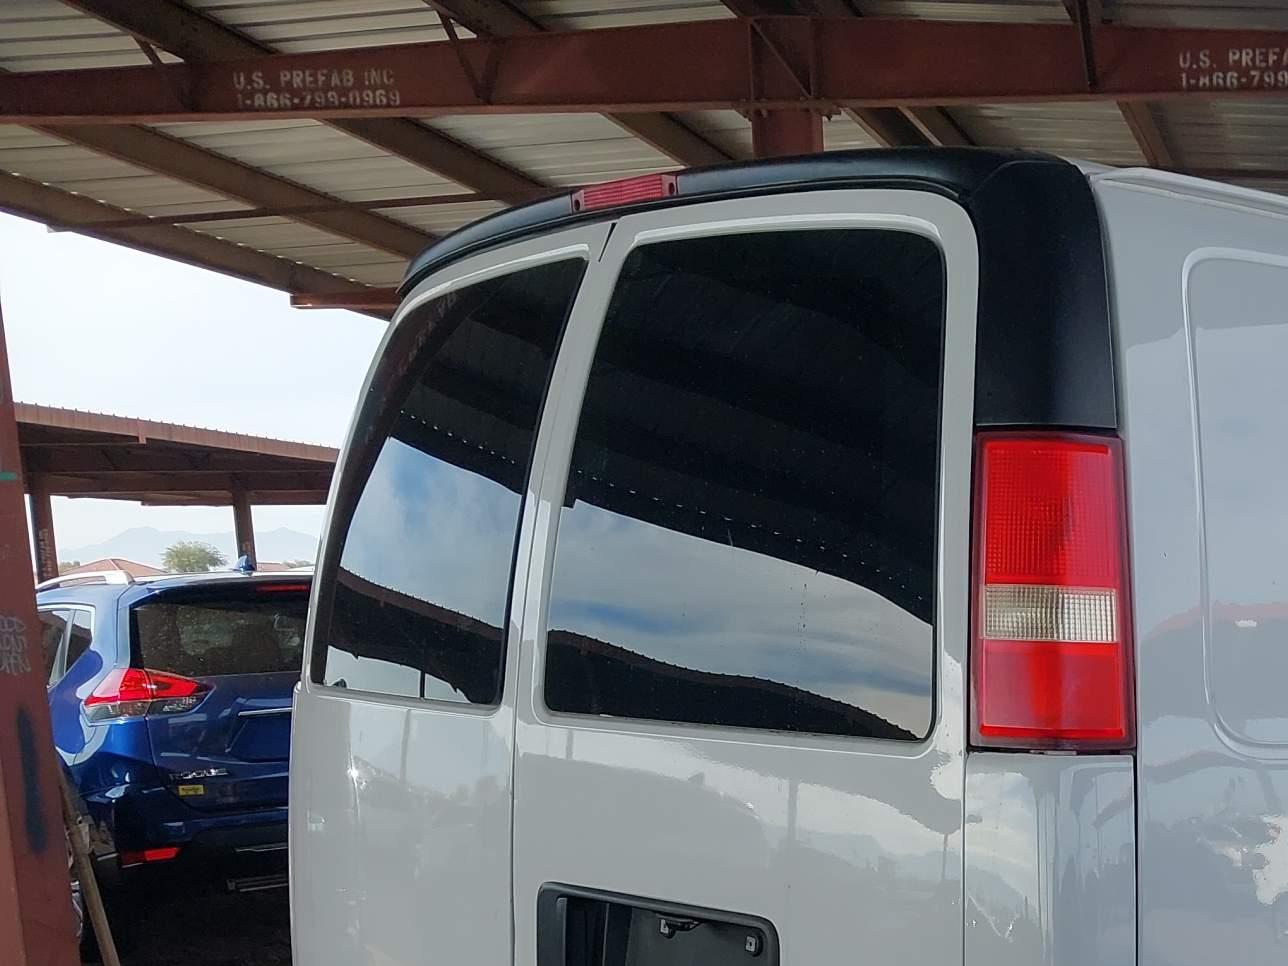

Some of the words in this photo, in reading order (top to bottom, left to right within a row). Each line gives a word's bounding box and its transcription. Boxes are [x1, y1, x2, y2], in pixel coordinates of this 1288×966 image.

[1179, 50, 1217, 68] U.S.
[233, 71, 271, 89] U.S.
[280, 69, 355, 89] PREFAB
